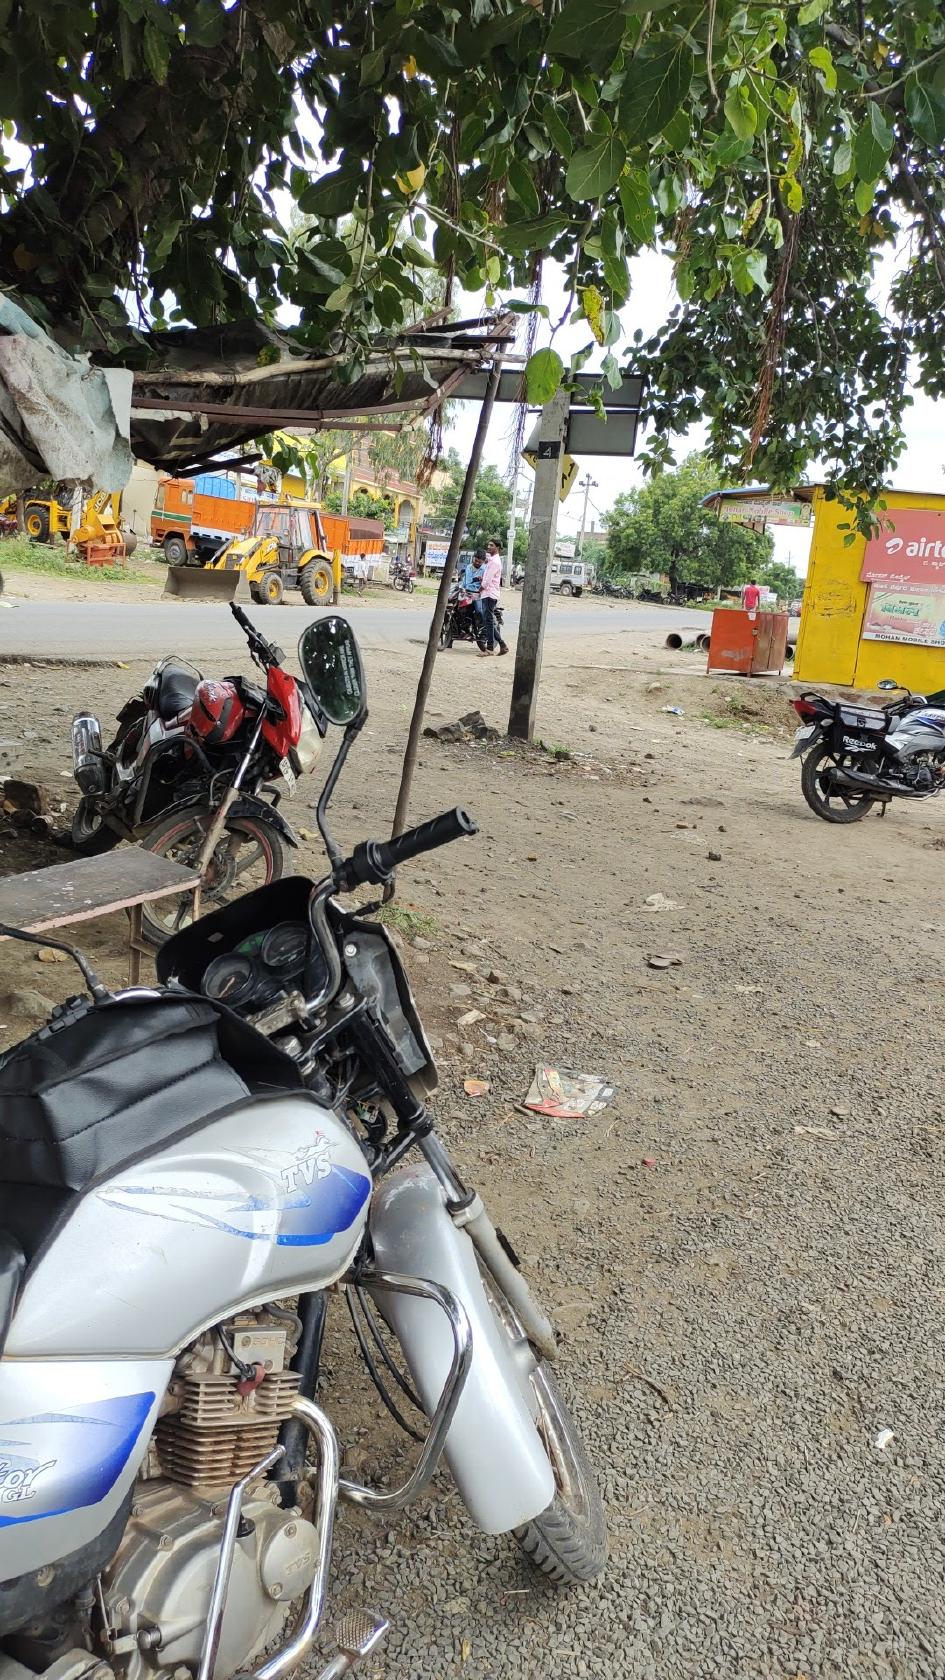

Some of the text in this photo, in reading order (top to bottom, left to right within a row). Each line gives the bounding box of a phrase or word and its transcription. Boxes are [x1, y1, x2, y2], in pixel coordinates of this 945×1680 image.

[543, 446, 552, 458] 4
[874, 633, 900, 641] MOHAN
[902, 636, 928, 644] MOBILE
[842, 735, 878, 750] Reebok
[281, 1153, 333, 1194] TVS
[2, 1486, 37, 1503] GL
